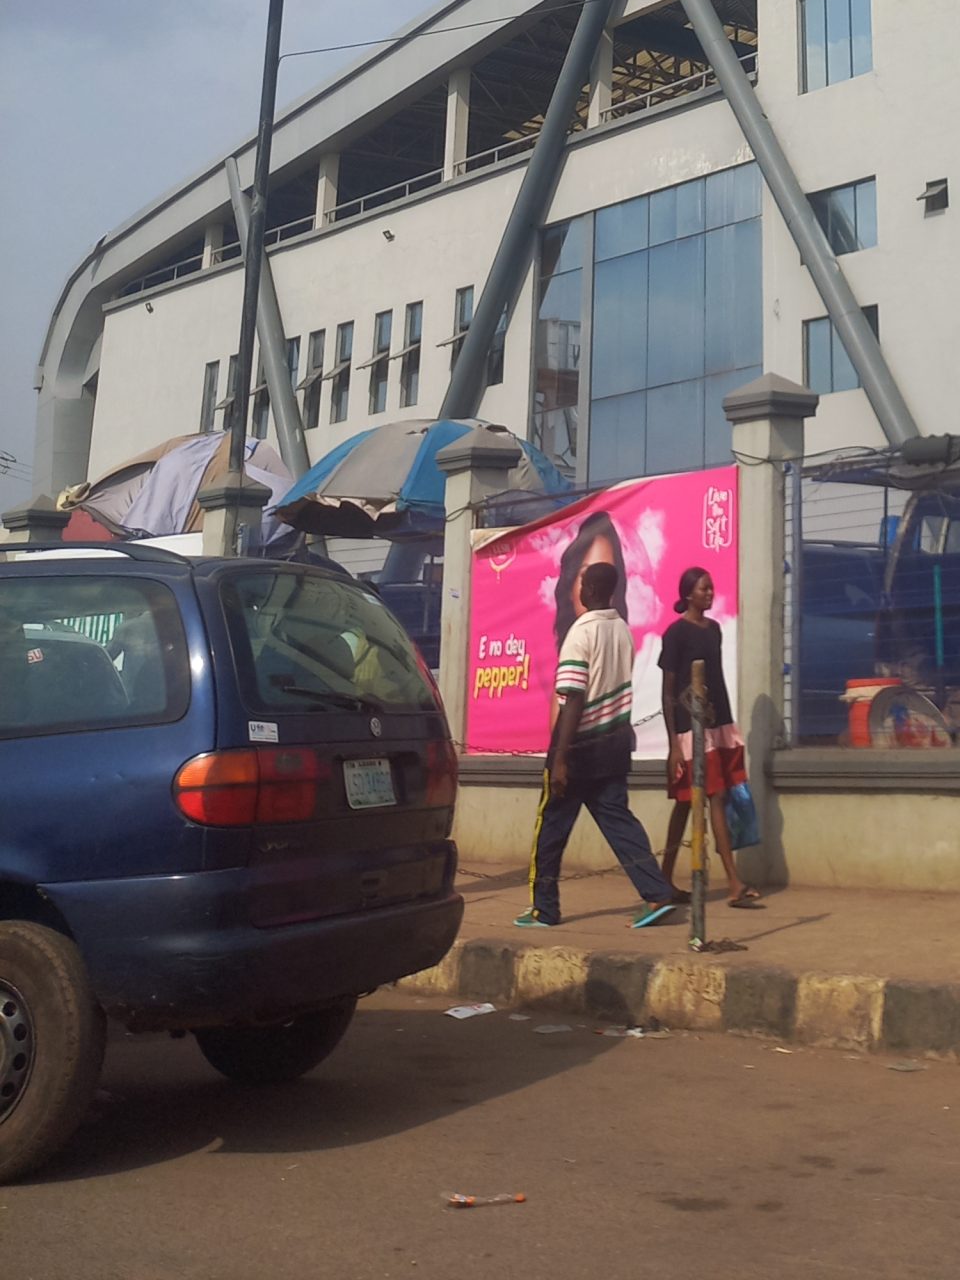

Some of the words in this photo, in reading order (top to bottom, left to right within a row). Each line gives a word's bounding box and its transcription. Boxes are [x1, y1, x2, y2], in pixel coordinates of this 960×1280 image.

[479, 635, 488, 659] E
[505, 633, 526, 663] dey
[473, 653, 530, 700] pepper!
